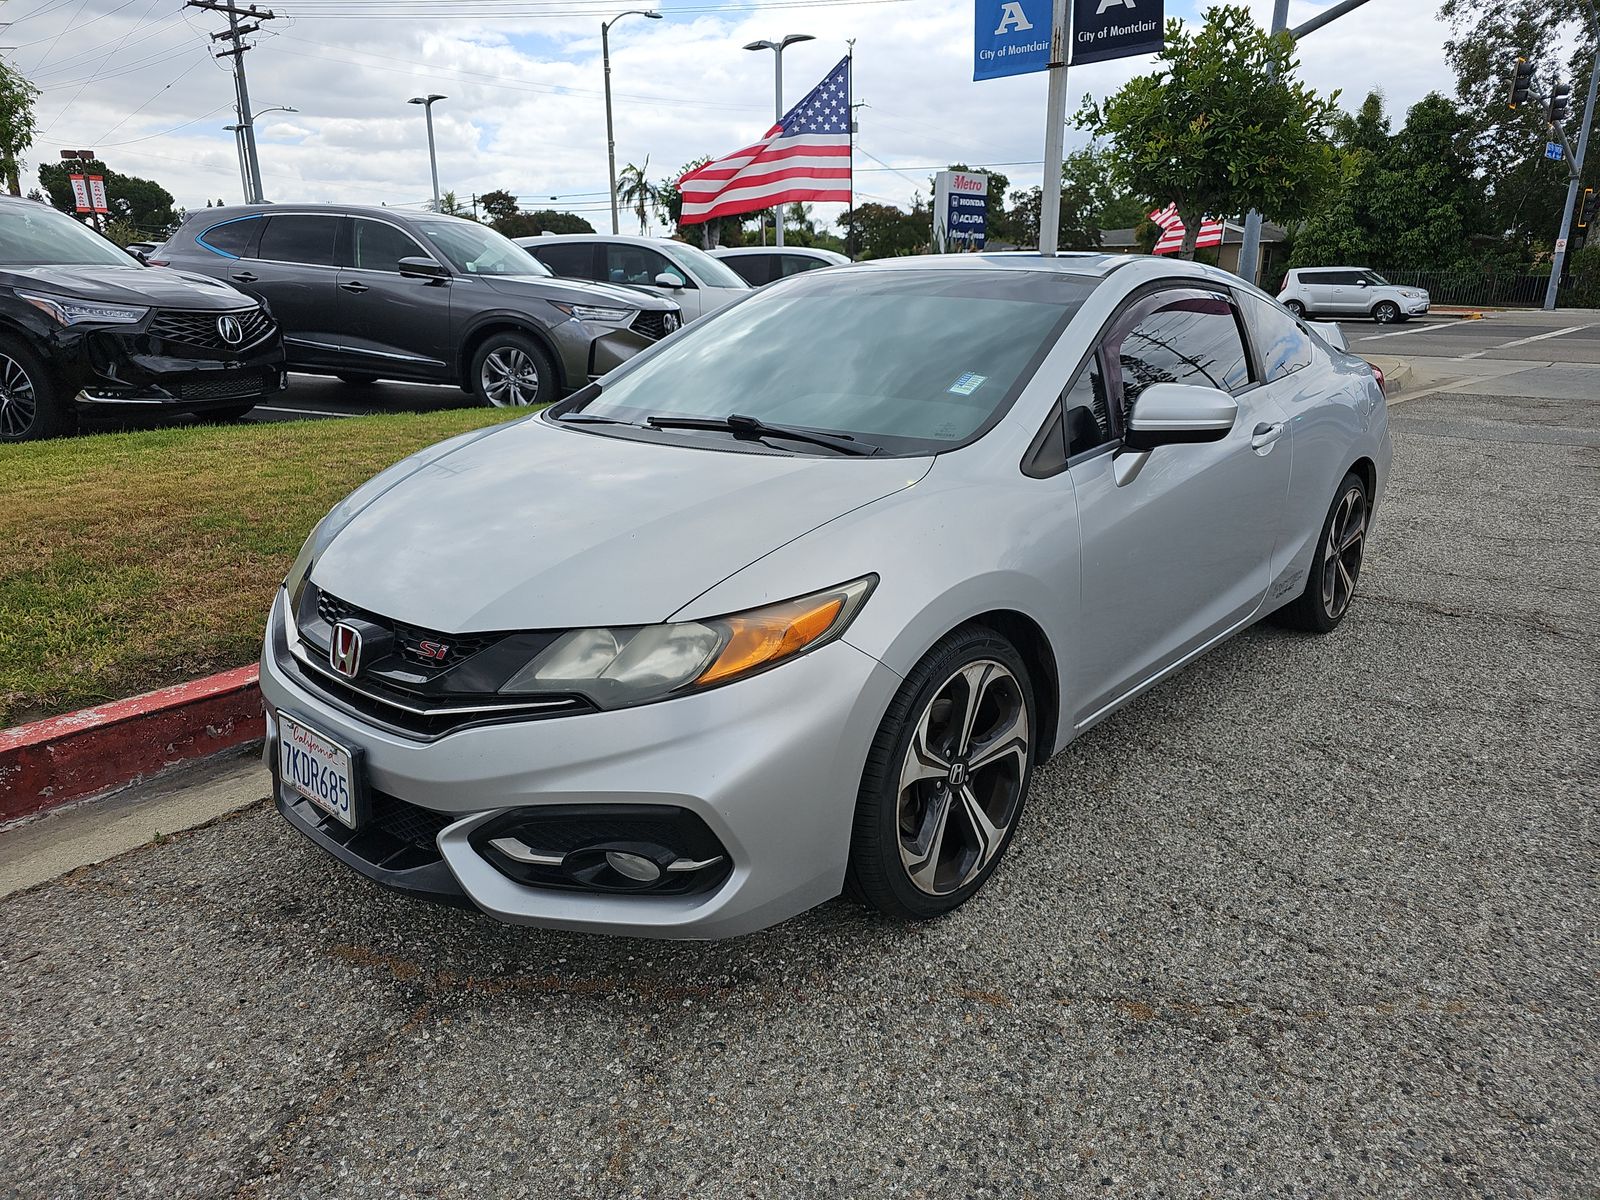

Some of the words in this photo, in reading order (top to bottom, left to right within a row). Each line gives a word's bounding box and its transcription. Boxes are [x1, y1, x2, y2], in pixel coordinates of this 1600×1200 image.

[1078, 31, 1096, 43] City
[1097, 27, 1108, 38] of
[1110, 20, 1157, 36] Montclair
[979, 49, 995, 61] City
[997, 47, 1007, 57] of
[1008, 40, 1050, 55] Montclair
[953, 175, 982, 191] Metro
[960, 198, 985, 207] HONDA
[959, 214, 984, 224] ACURA
[293, 725, 339, 766] California
[283, 741, 349, 812] 7KDR685
